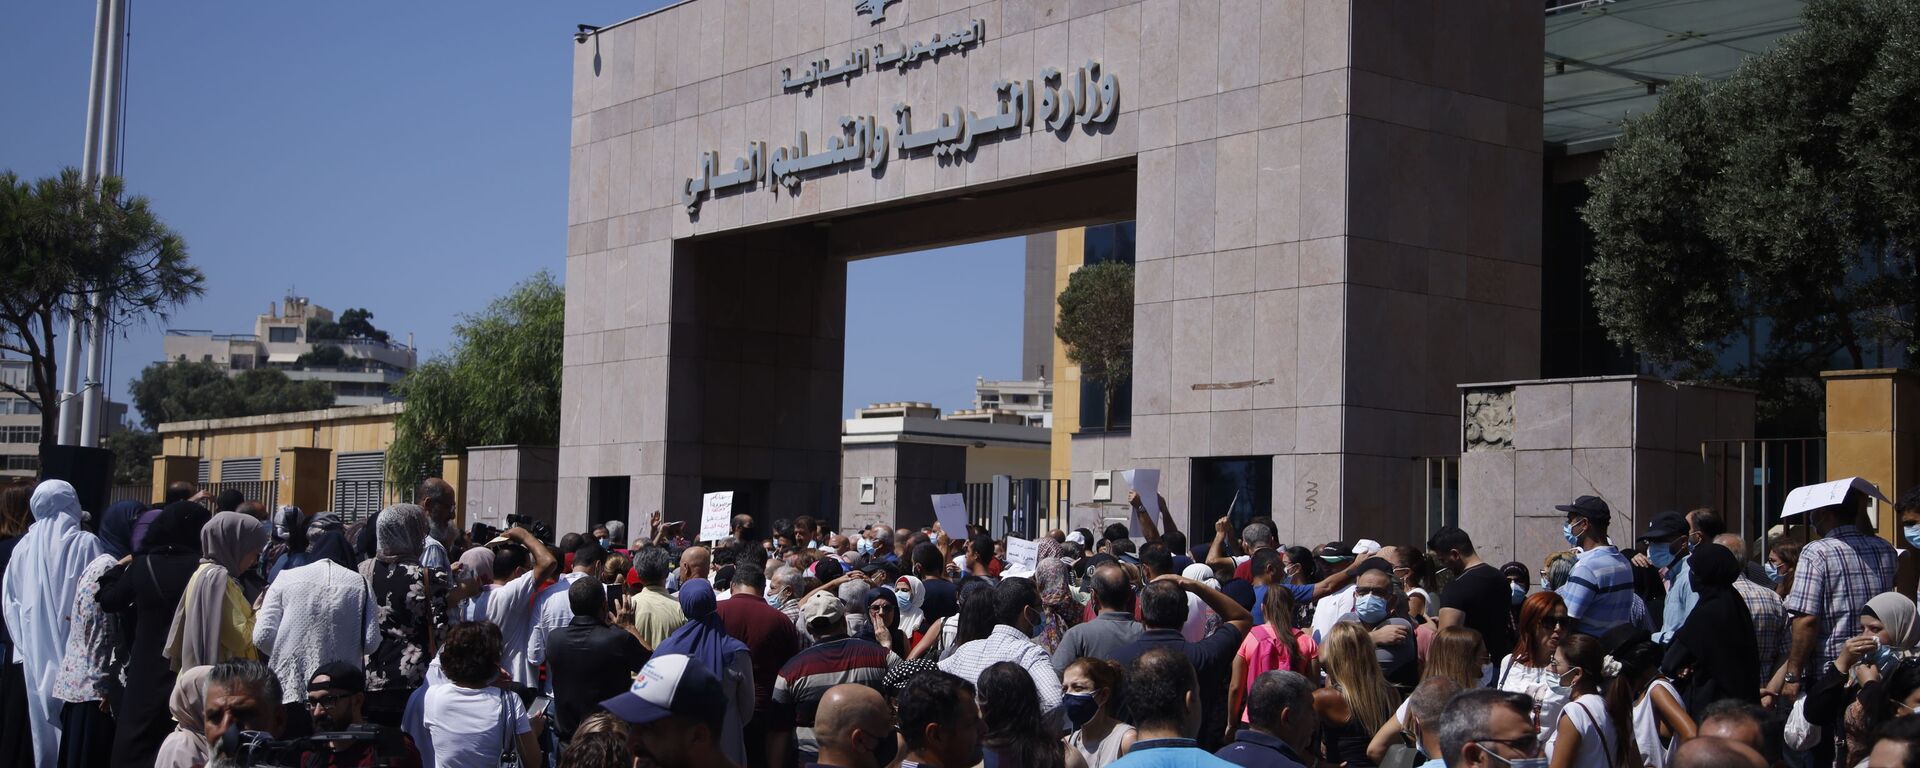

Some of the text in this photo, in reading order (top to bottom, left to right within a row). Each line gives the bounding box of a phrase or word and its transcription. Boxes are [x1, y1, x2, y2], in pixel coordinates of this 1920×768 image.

[782, 18, 985, 92] الجمهورية اللبنانية
[682, 58, 1120, 214] وزارة التربية والتعليم العالي
